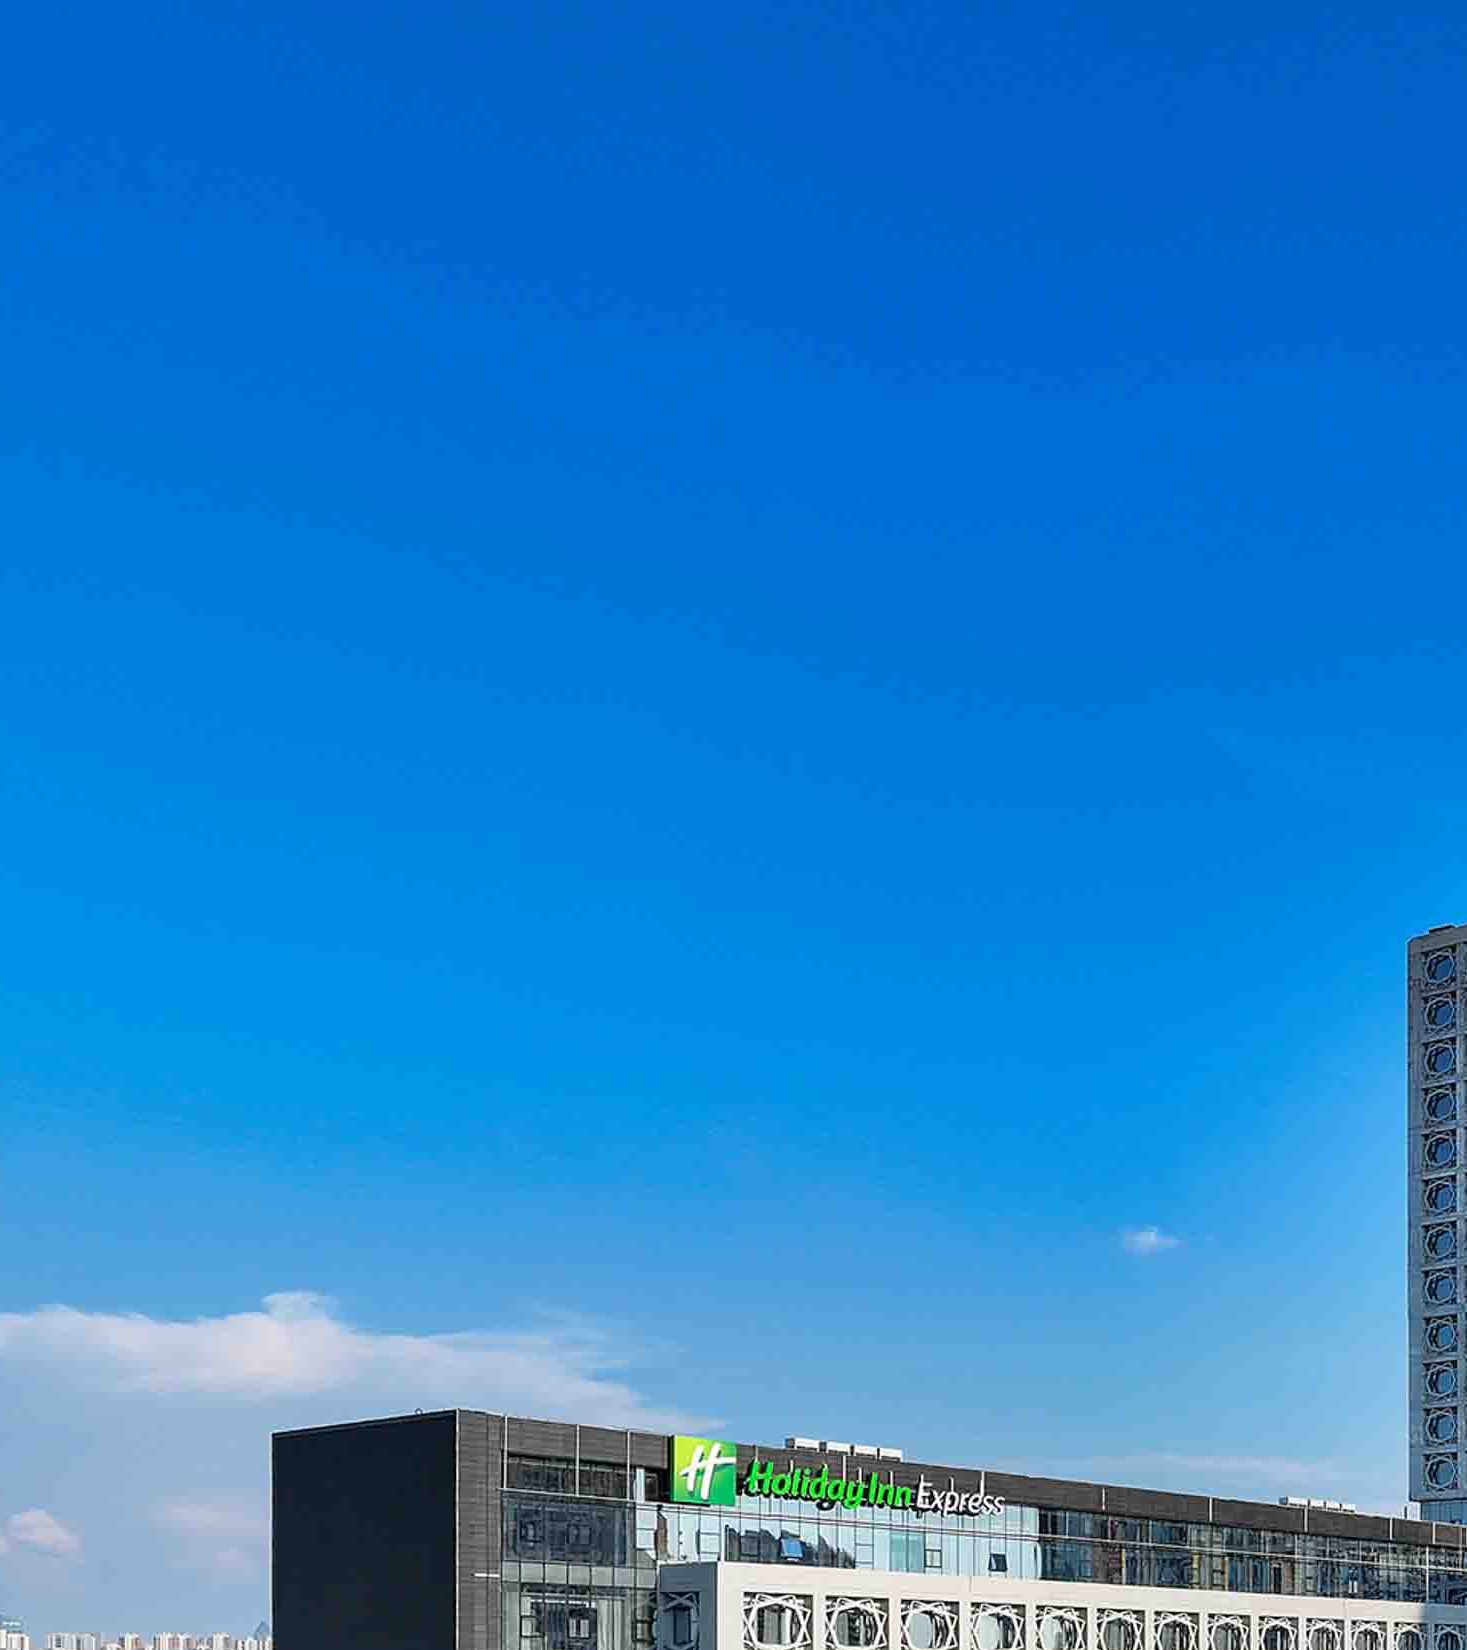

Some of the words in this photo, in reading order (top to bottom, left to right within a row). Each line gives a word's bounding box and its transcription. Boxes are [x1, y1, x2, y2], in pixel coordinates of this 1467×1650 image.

[747, 1459, 863, 1509] Holiday
[869, 1472, 912, 1508] Inn
[917, 1476, 1007, 1518] Express
